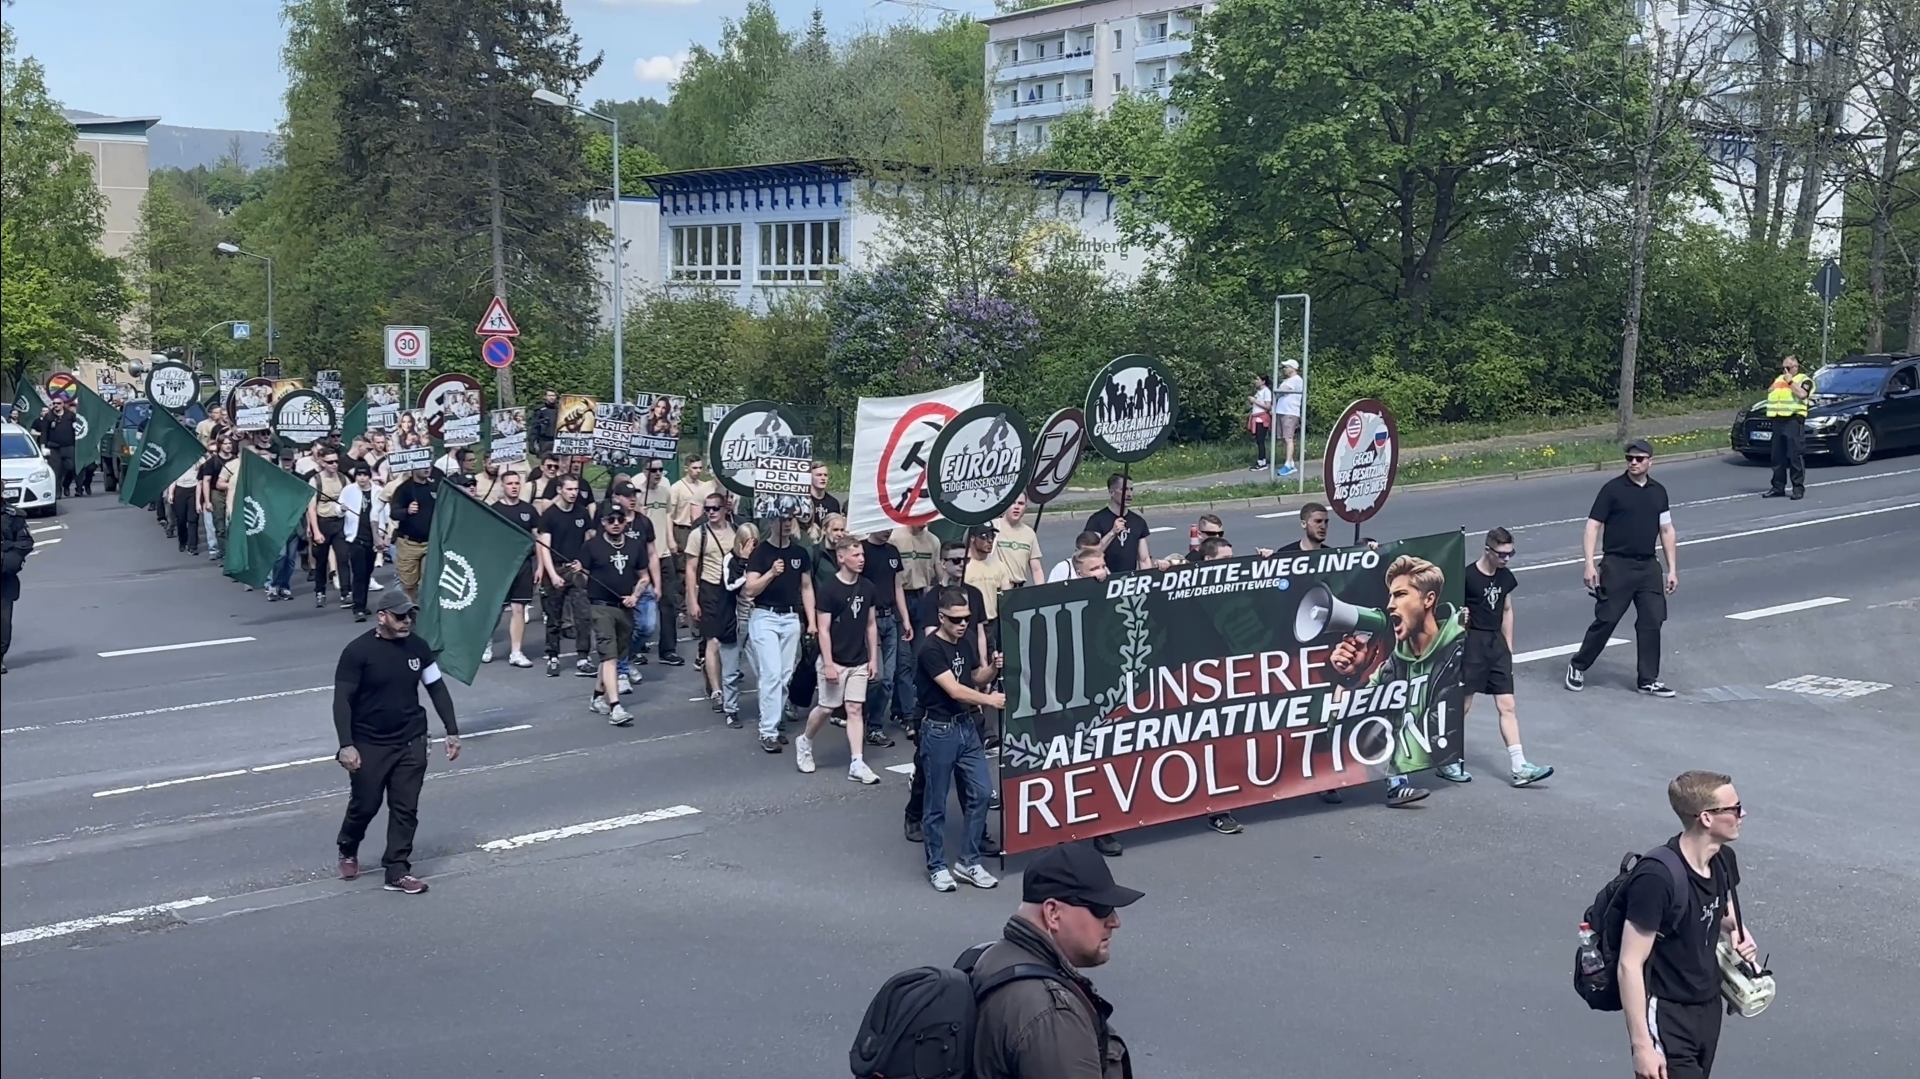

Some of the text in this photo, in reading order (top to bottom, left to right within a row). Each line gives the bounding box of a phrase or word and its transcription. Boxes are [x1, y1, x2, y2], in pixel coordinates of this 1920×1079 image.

[399, 338, 415, 350] 30
[153, 370, 192, 380] GRENZEN
[560, 439, 589, 447] MIETEN
[602, 430, 630, 440] DEN
[1108, 427, 1159, 443] MACHEN WIR
[756, 457, 810, 471] KRIEG
[941, 447, 1022, 483] EUROPA
[1352, 450, 1374, 466] GEGEN
[765, 471, 800, 482] DEN
[1351, 462, 1389, 481] BESATZUNG
[756, 481, 809, 493] DROGEN!
[944, 474, 1018, 493] EIDGENOSSENSCHAFT
[1334, 484, 1349, 500] AUS
[1350, 483, 1364, 498] OST
[1106, 551, 1380, 599] DER-DRITTE-WEG.INFO
[1167, 578, 1280, 601] T.ME/DERDRITTEWEG
[1126, 645, 1331, 714] UNSERE
[1042, 695, 1312, 770] ALTERNATIVE
[1018, 701, 1448, 834] REVOLUTION!
